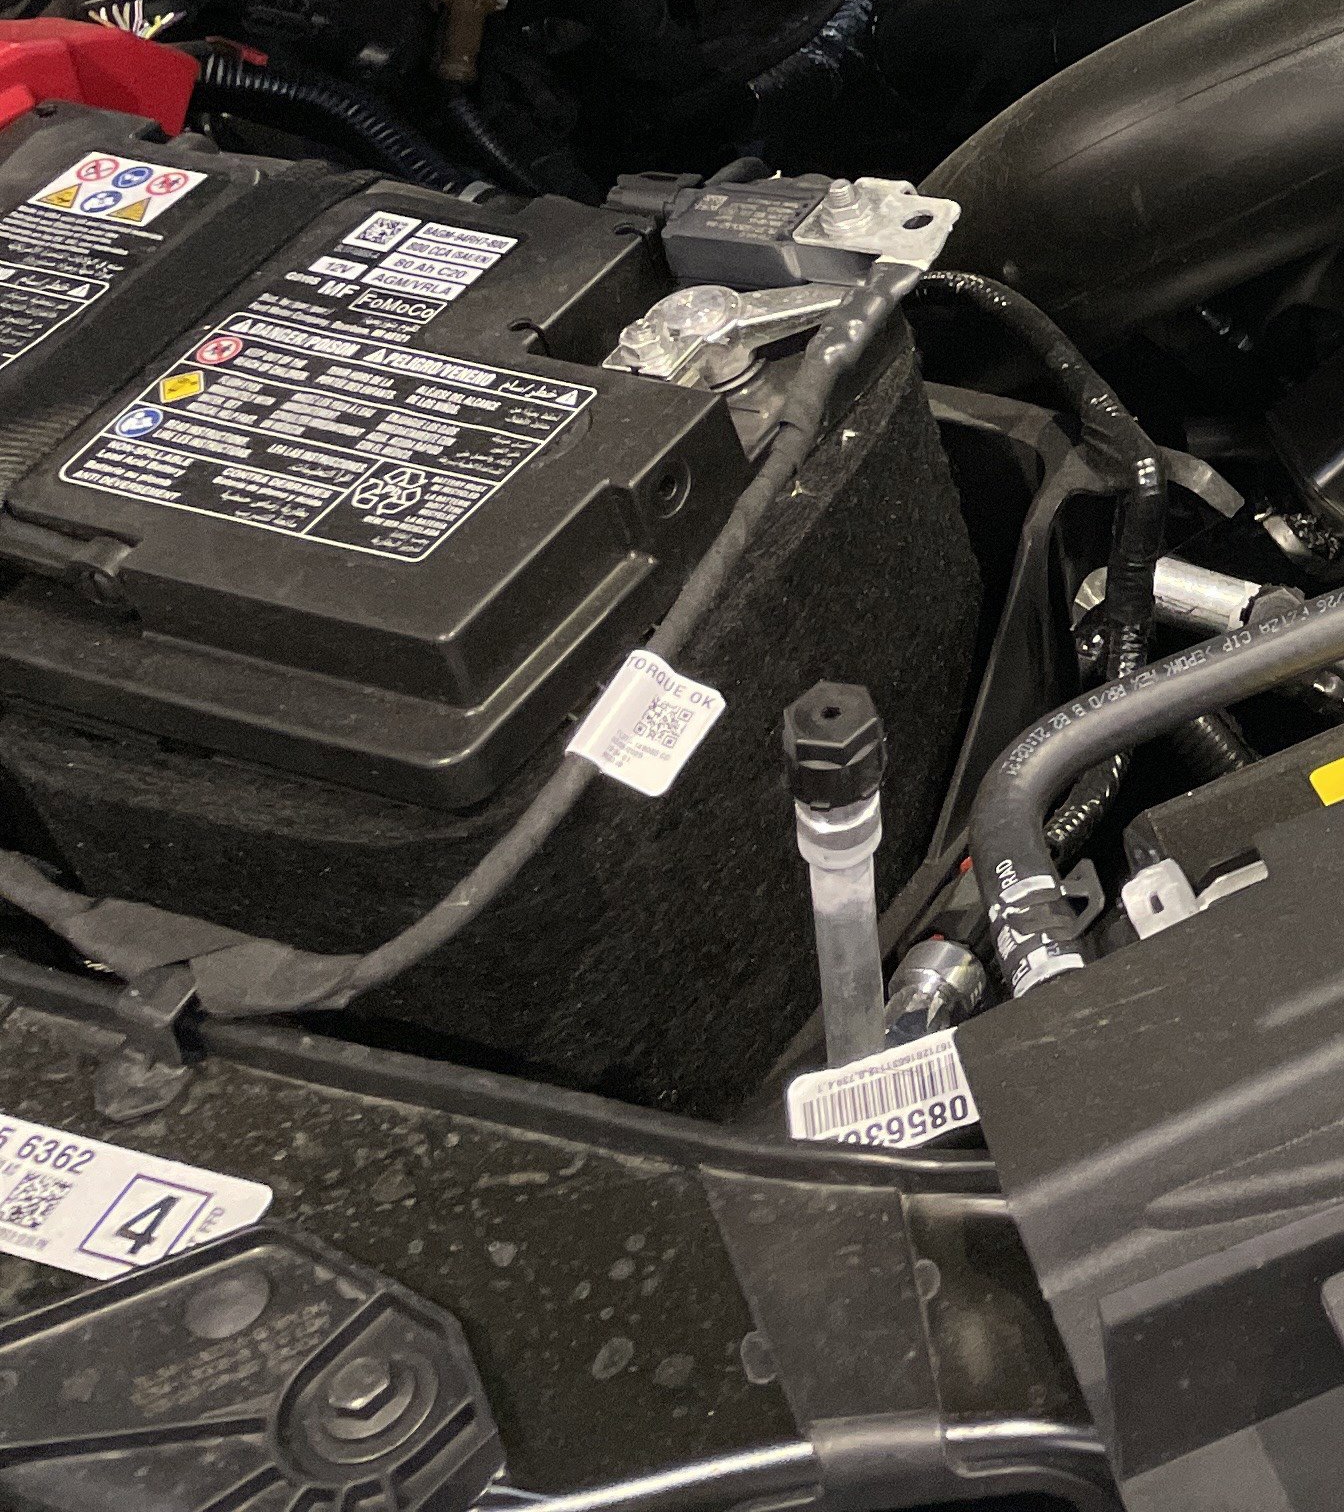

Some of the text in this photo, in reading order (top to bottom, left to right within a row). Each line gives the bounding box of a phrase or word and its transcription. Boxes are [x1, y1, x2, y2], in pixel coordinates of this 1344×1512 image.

[325, 262, 353, 273] 12V
[413, 263, 435, 273] Ah
[437, 267, 467, 279] C20
[317, 280, 360, 298] MF
[372, 273, 451, 295] AGM/VRLA
[357, 293, 435, 319] FoMoCo
[247, 323, 361, 356] DANGER/POISON
[383, 352, 497, 387] PELIGRO/VENENO
[1223, 631, 1251, 652] CIP
[626, 655, 716, 710] TORQUE OK
[995, 859, 1018, 890] RAD
[17, 1134, 96, 1175] 6362
[115, 1194, 182, 1256] 4
